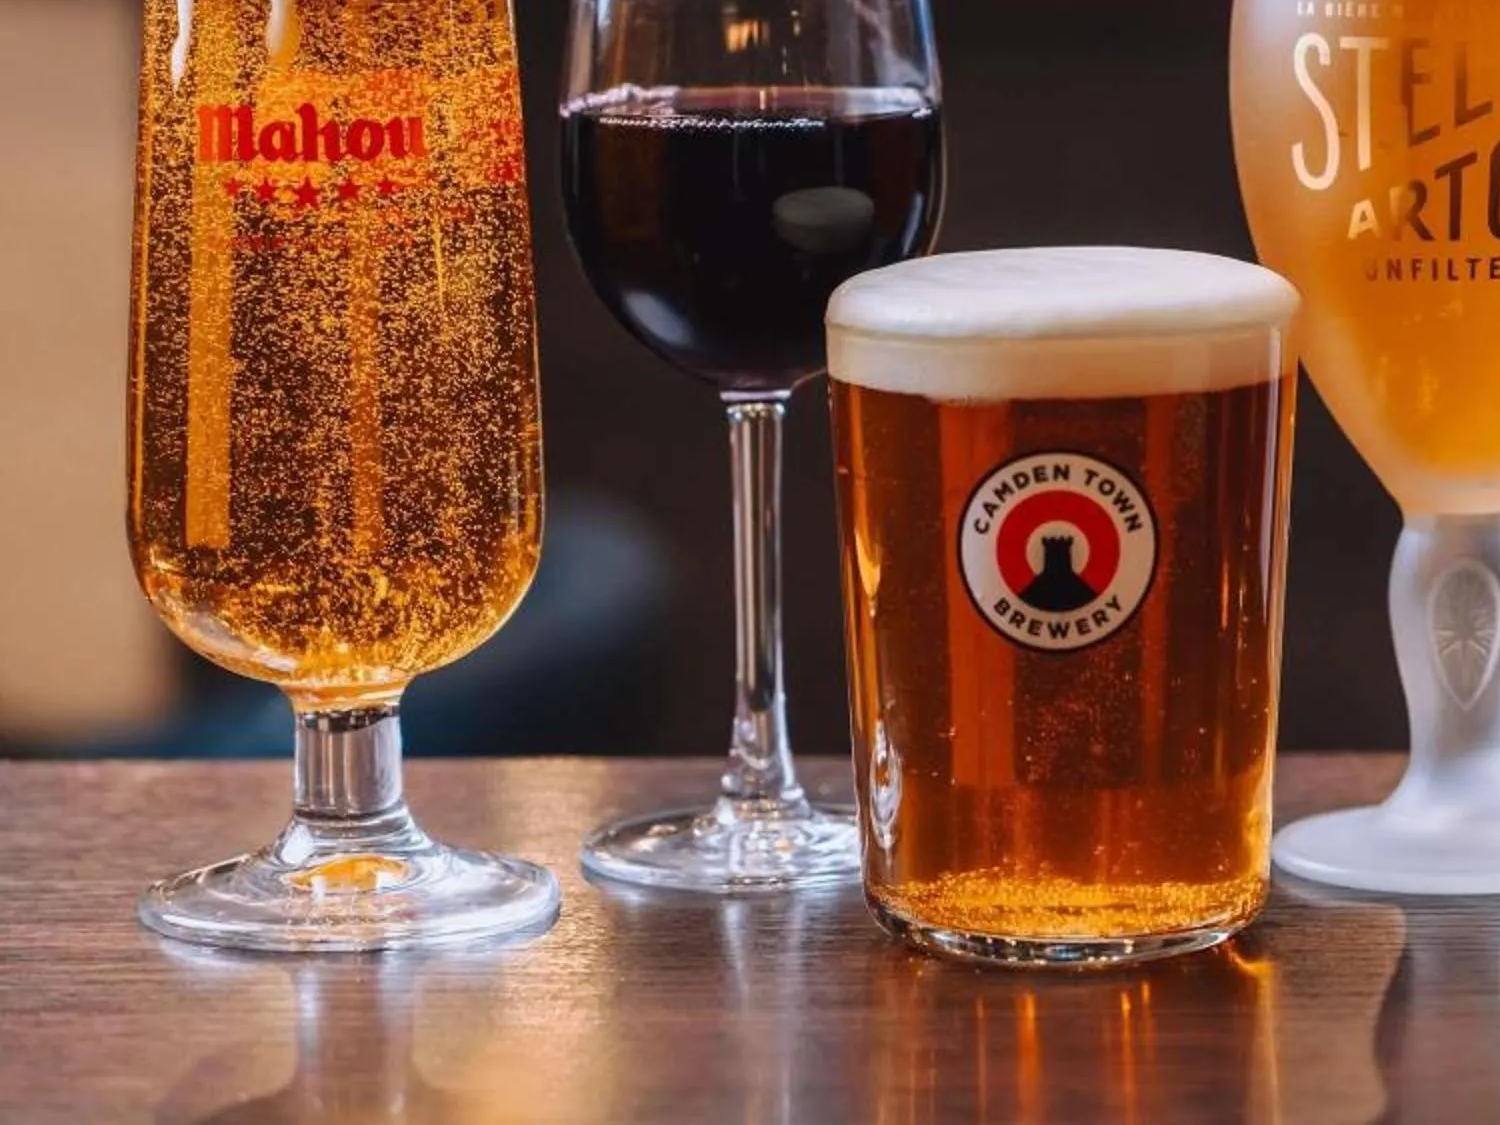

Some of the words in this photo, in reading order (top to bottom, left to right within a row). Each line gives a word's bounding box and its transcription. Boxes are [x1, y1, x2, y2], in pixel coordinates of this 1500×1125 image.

[196, 103, 427, 163] Mahou
[973, 463, 1071, 535] CAMDEN
[1084, 469, 1144, 533] TOWN
[993, 595, 1122, 640] BREWERY
